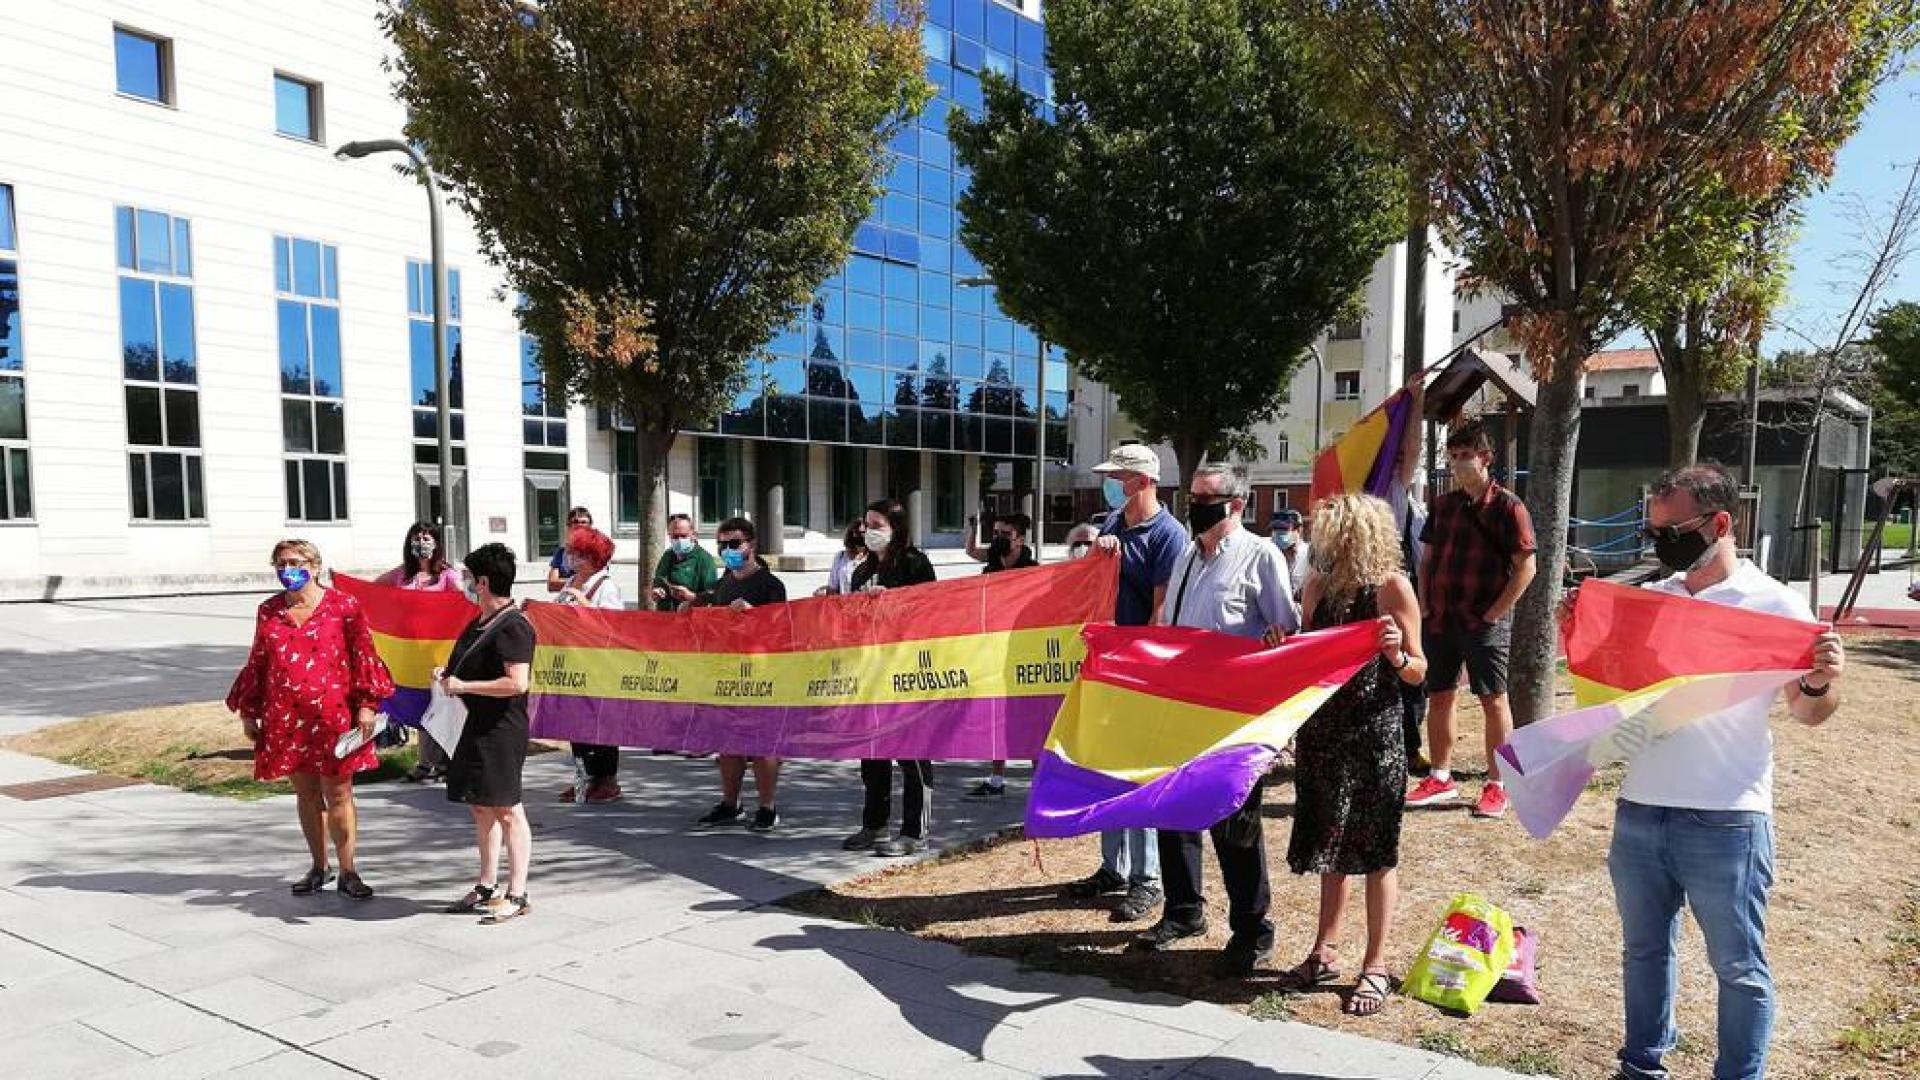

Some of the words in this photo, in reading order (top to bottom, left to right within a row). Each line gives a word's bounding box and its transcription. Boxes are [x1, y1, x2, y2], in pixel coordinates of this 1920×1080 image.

[1046, 638, 1060, 658] III
[919, 650, 932, 668] III
[535, 670, 587, 688] EPÚBLICA
[740, 663, 752, 678] III
[1015, 661, 1081, 685] REPÚBLI
[893, 669, 969, 692] REPÚBLICA
